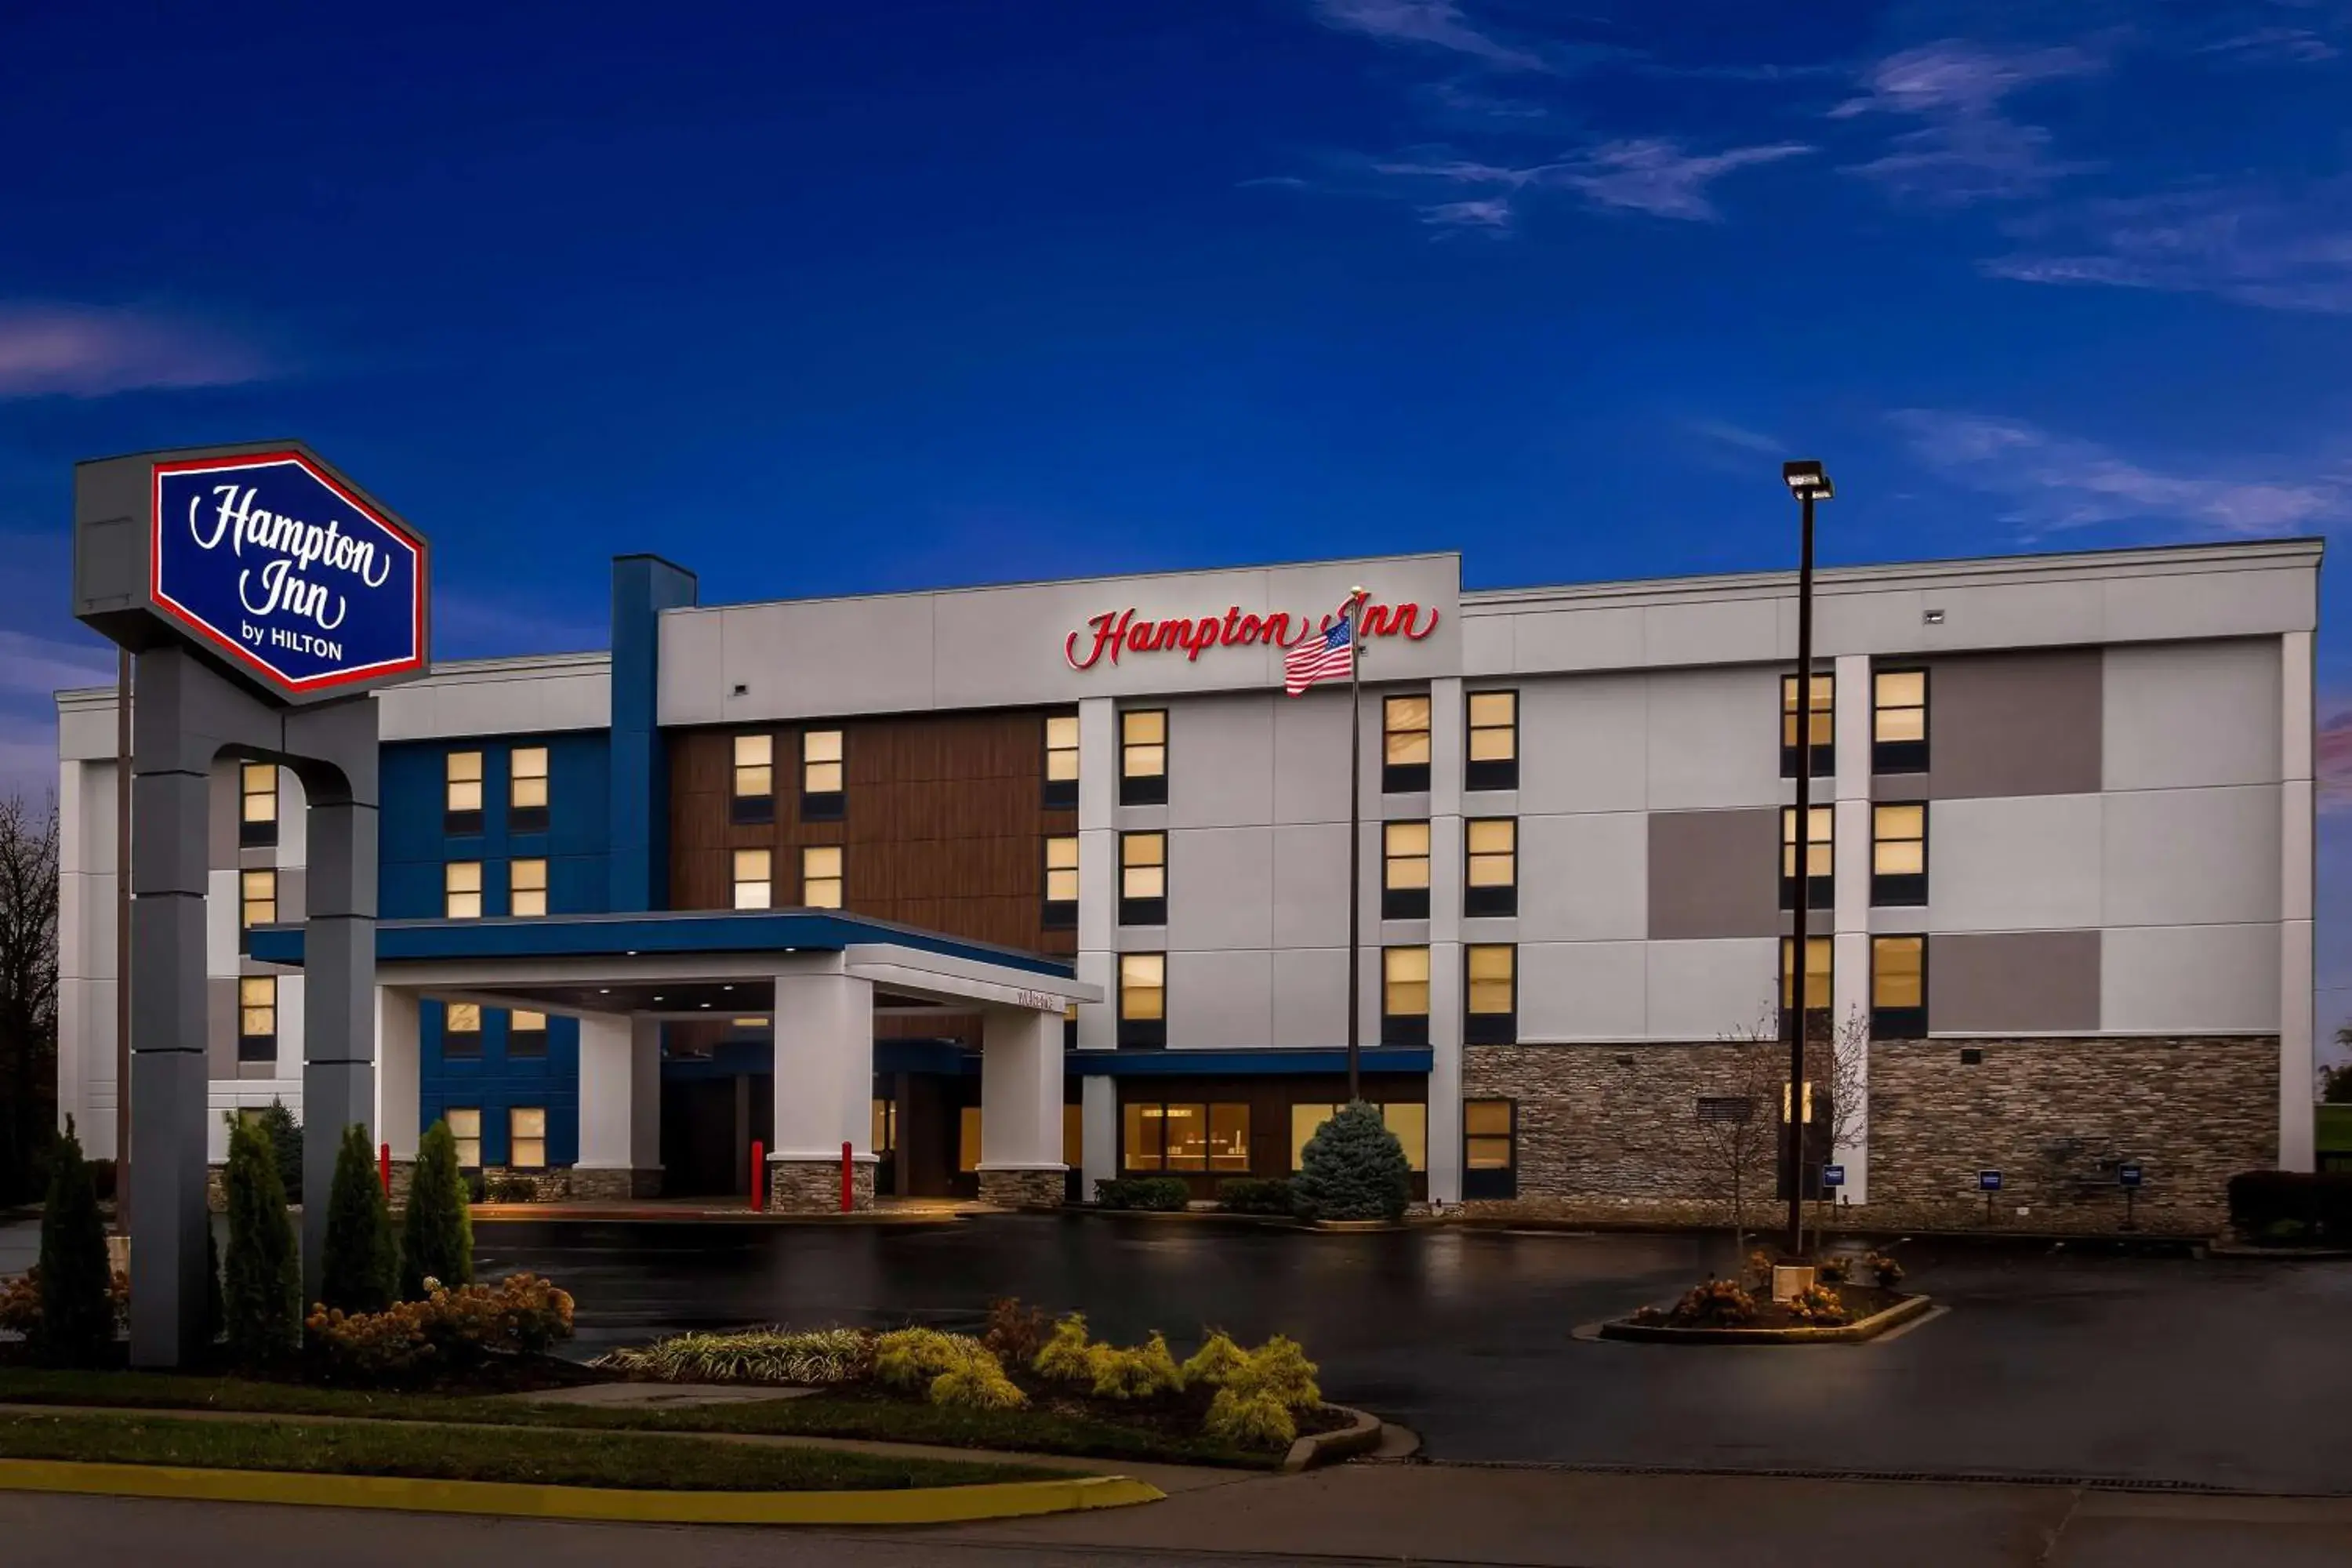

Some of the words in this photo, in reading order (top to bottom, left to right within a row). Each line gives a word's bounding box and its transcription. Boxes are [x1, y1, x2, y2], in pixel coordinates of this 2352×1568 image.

[190, 485, 390, 587] Hampton
[239, 560, 346, 630] Inn
[242, 620, 264, 646] by
[272, 629, 343, 661] HILTON
[1065, 607, 1310, 671] Hampton
